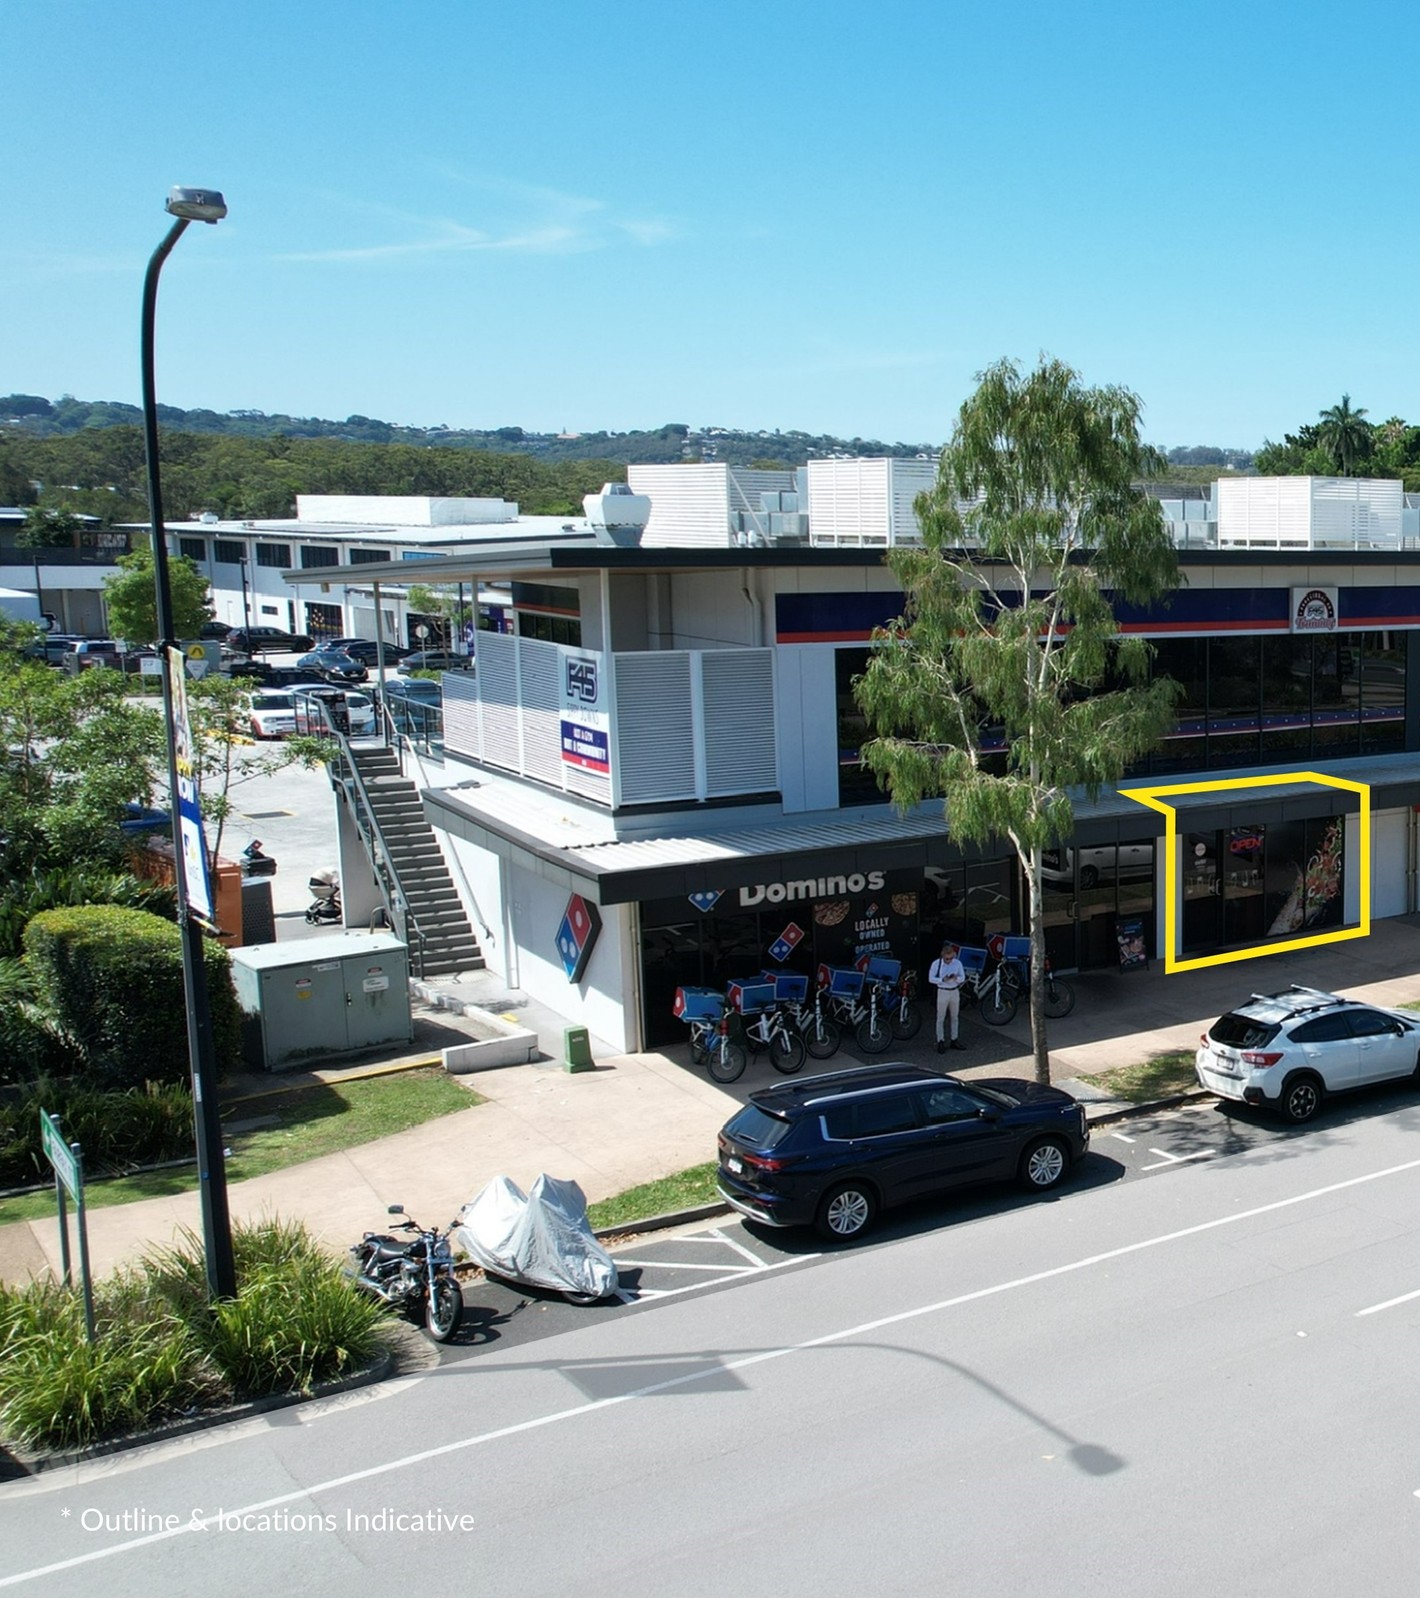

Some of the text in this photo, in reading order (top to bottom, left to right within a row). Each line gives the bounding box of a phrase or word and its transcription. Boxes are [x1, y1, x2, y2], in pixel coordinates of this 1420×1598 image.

[566, 656, 597, 704] F45
[1230, 838, 1264, 852] OPEN
[739, 870, 886, 907] Domino's
[855, 917, 889, 932] LOCALLY
[859, 929, 886, 941] OWNED
[855, 941, 891, 954] OPERATED
